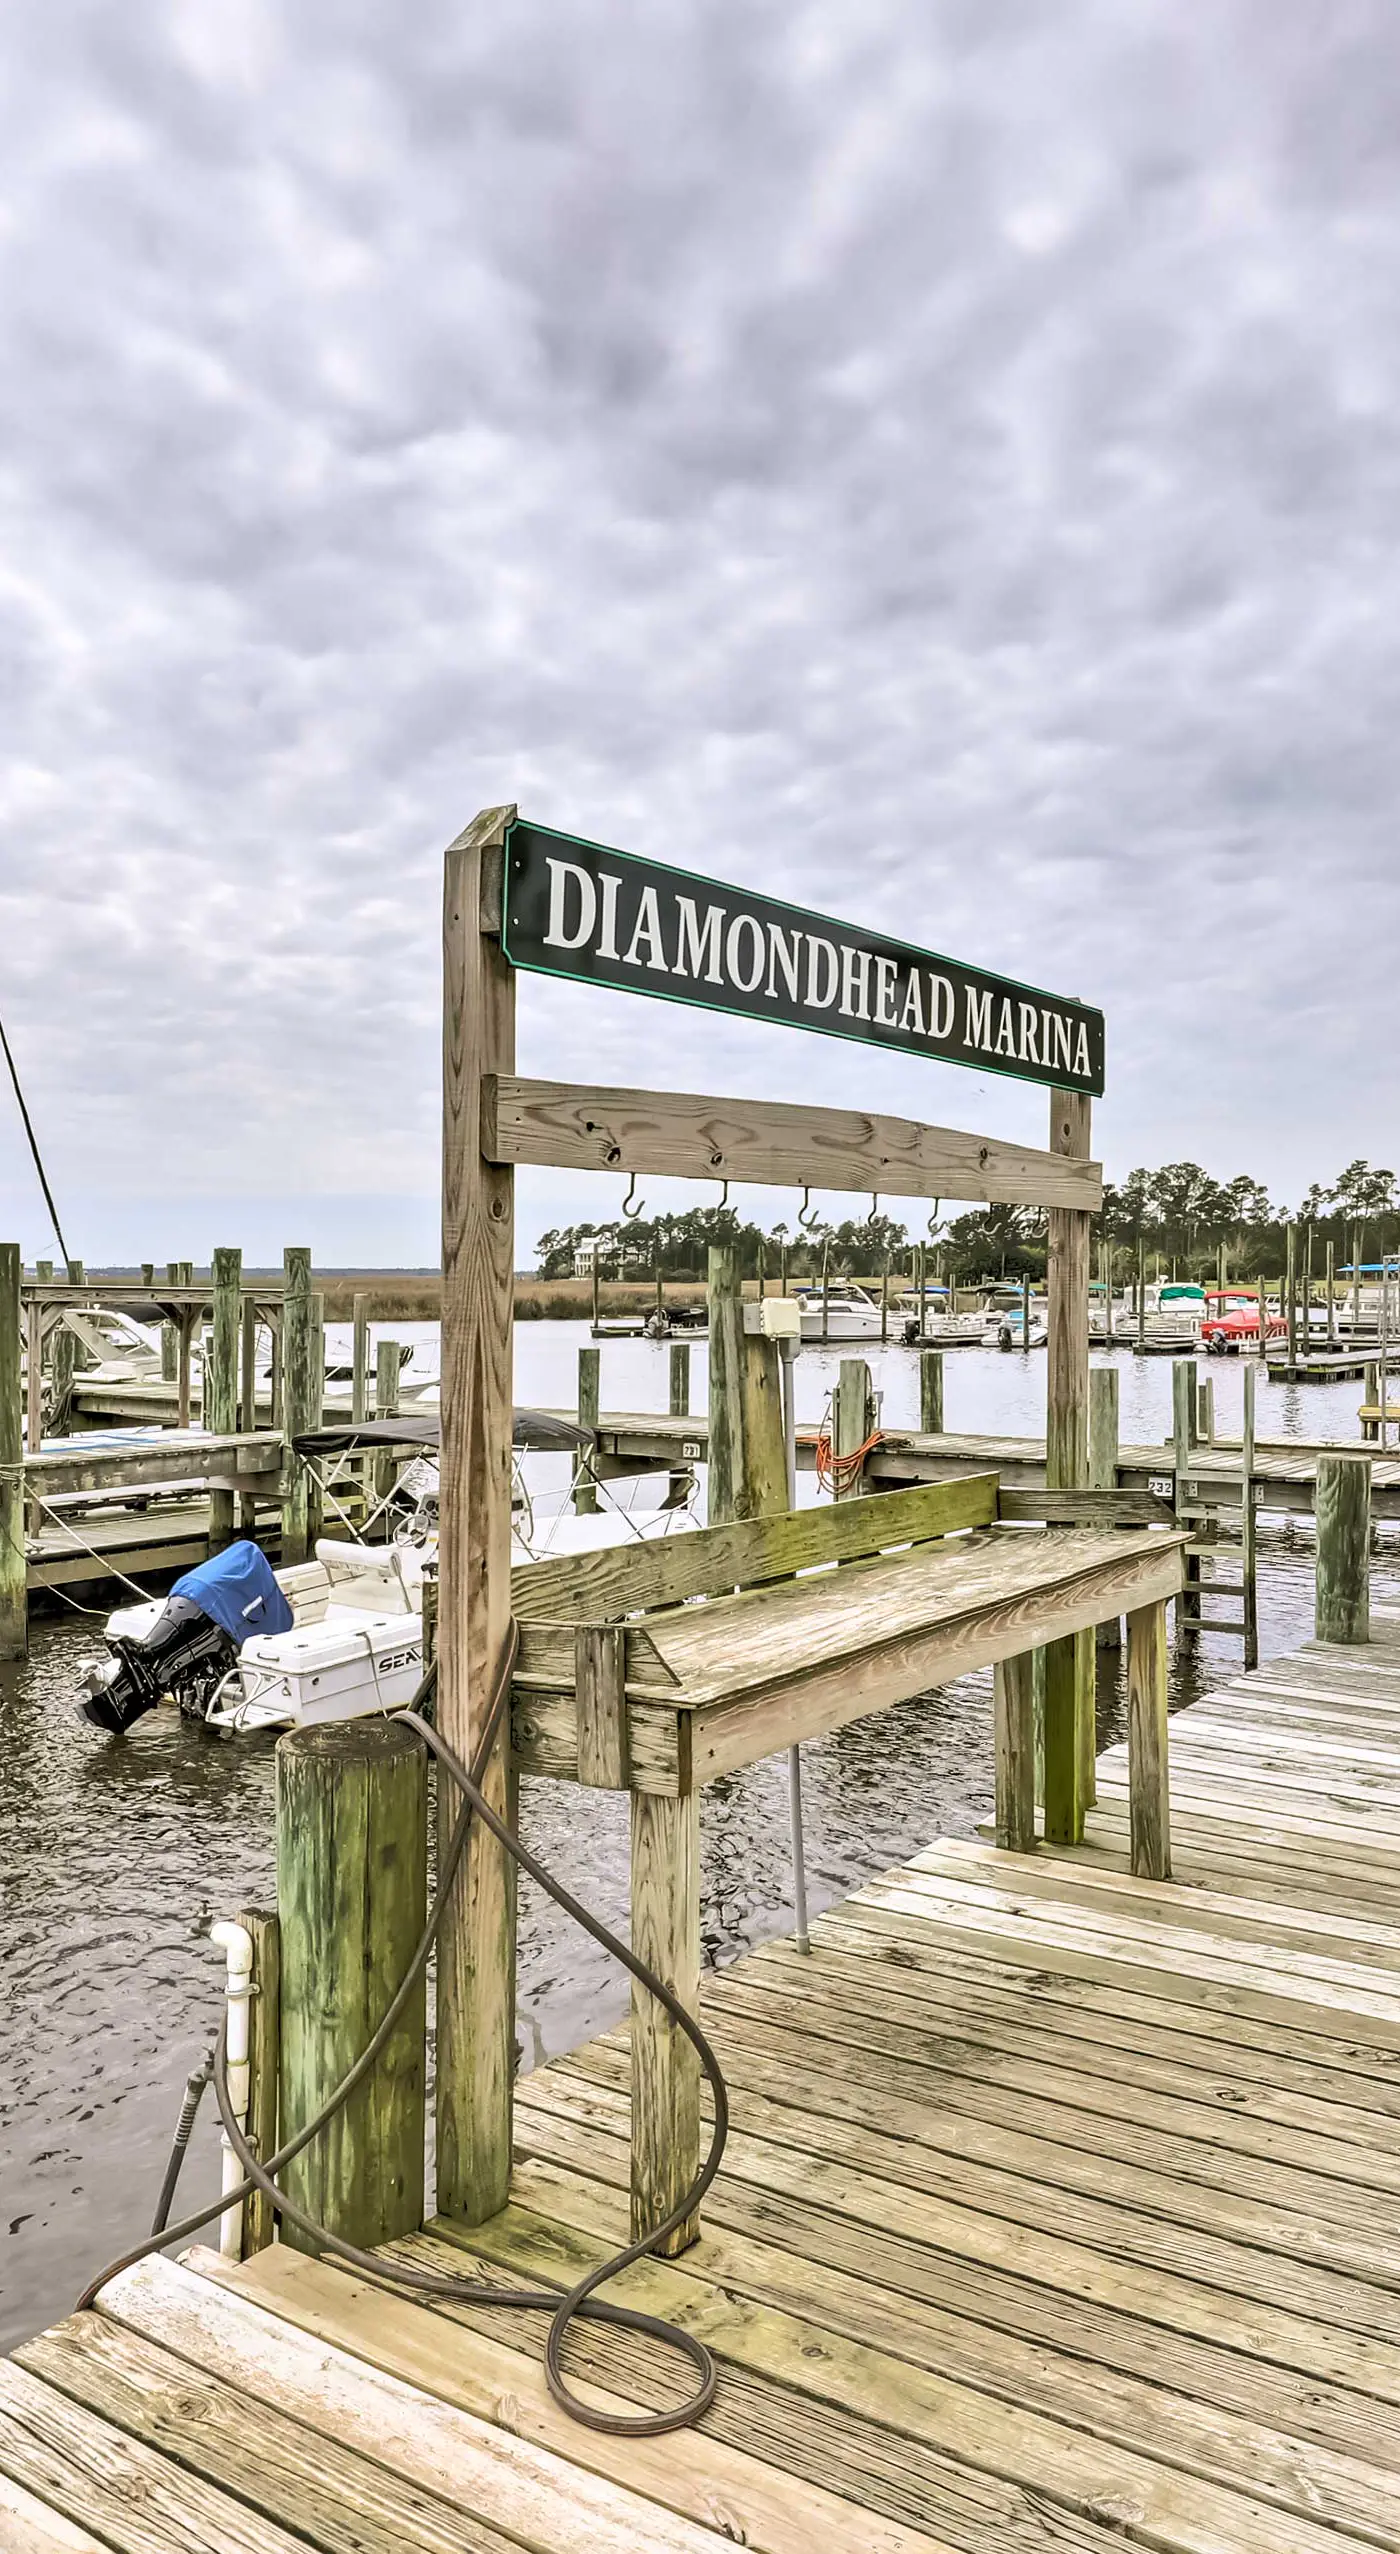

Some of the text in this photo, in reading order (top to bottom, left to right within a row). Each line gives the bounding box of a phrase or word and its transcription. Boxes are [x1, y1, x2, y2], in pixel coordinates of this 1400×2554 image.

[543, 857, 1092, 1077] DIAMONDHEAD MARINA
[1149, 1481, 1171, 1493] 232
